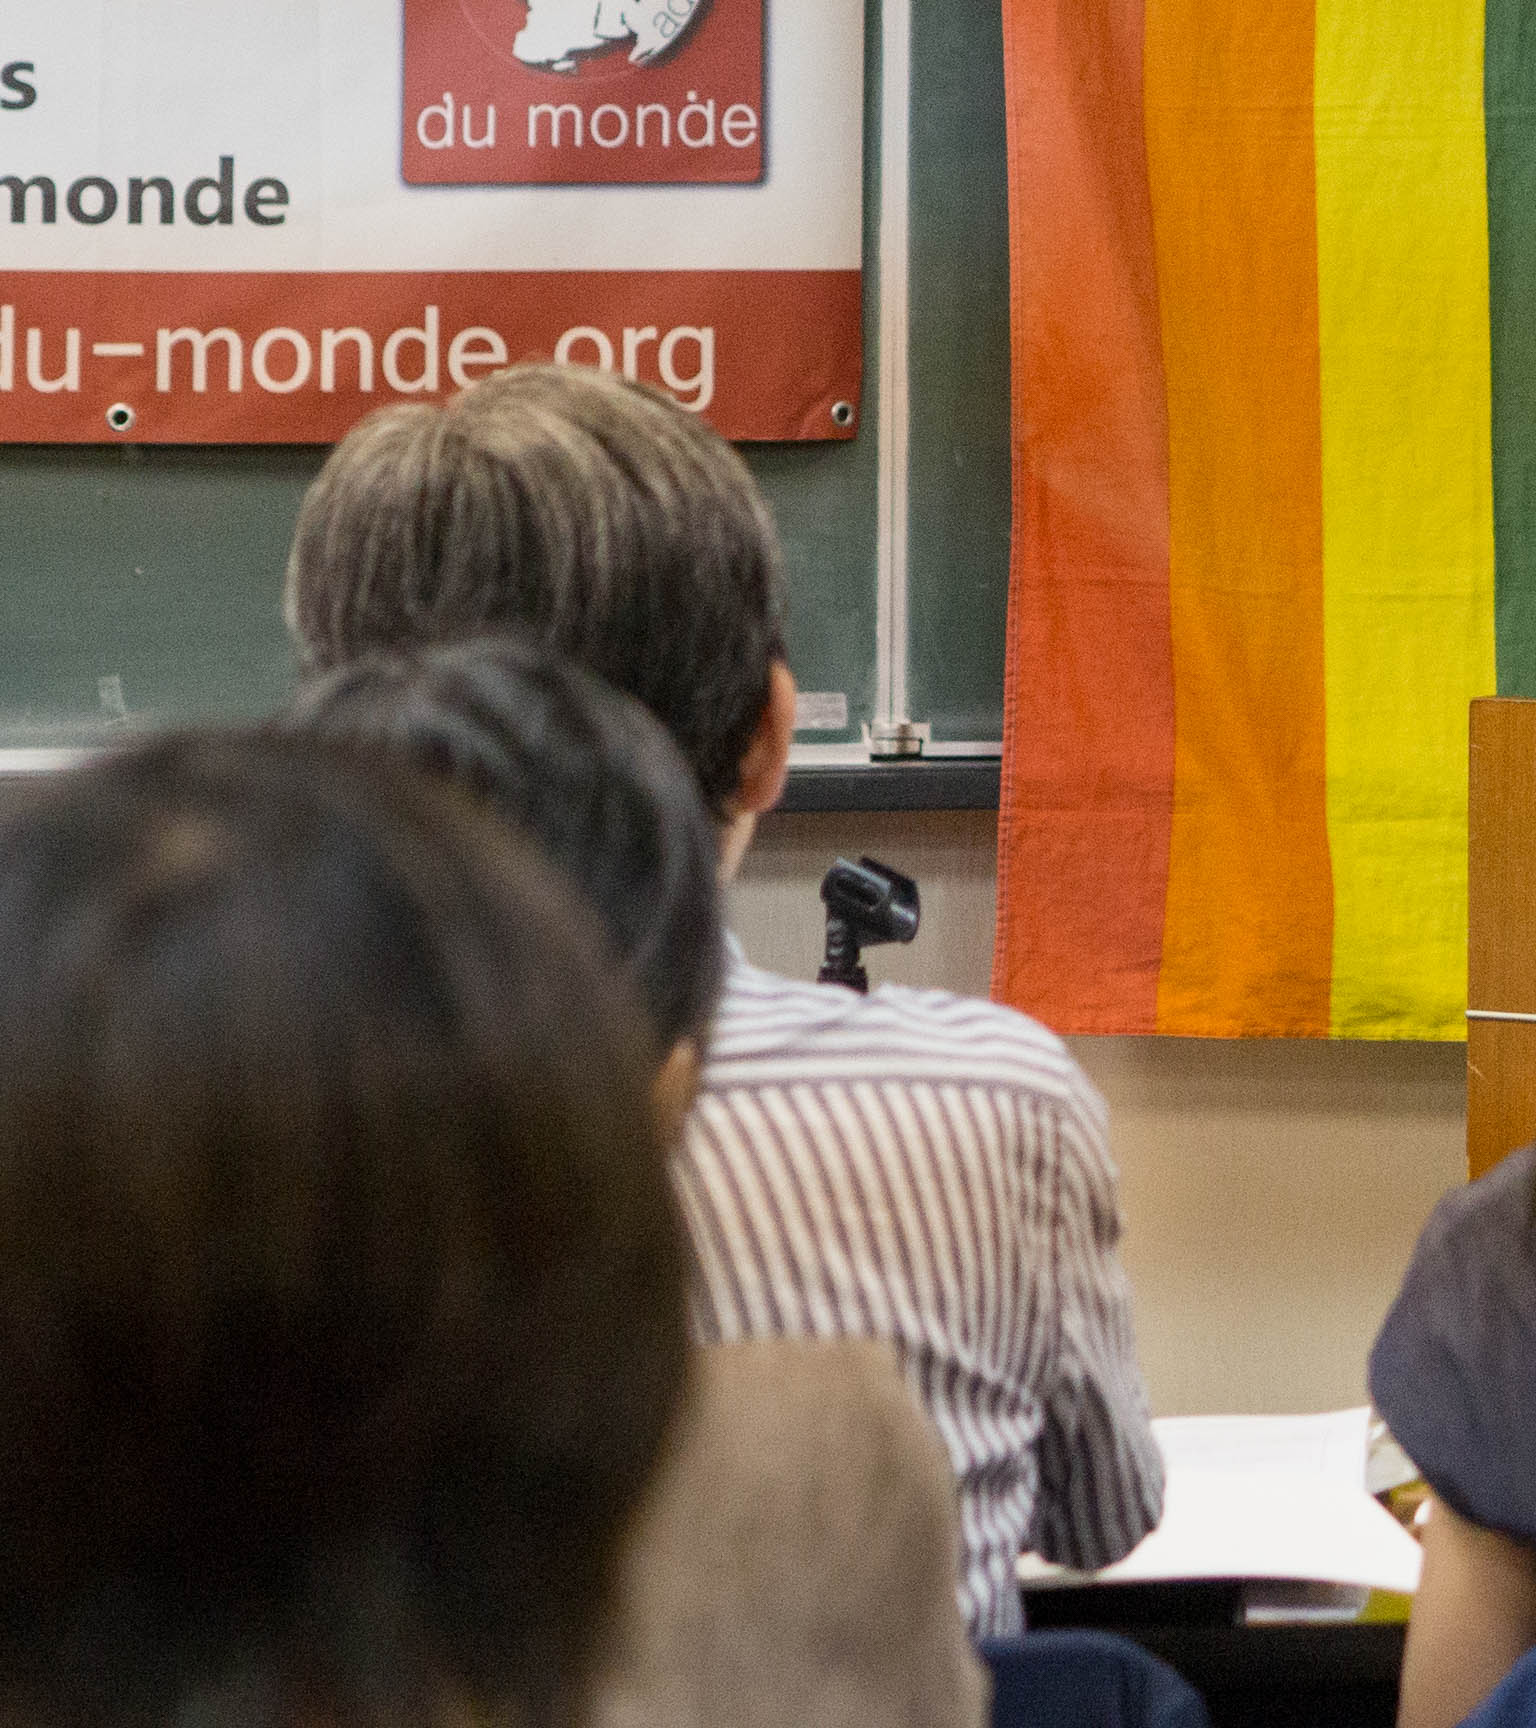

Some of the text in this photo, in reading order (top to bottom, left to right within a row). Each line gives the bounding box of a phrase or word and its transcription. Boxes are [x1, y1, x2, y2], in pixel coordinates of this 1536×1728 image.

[417, 89, 758, 149] du monde
[0, 154, 290, 226] monde
